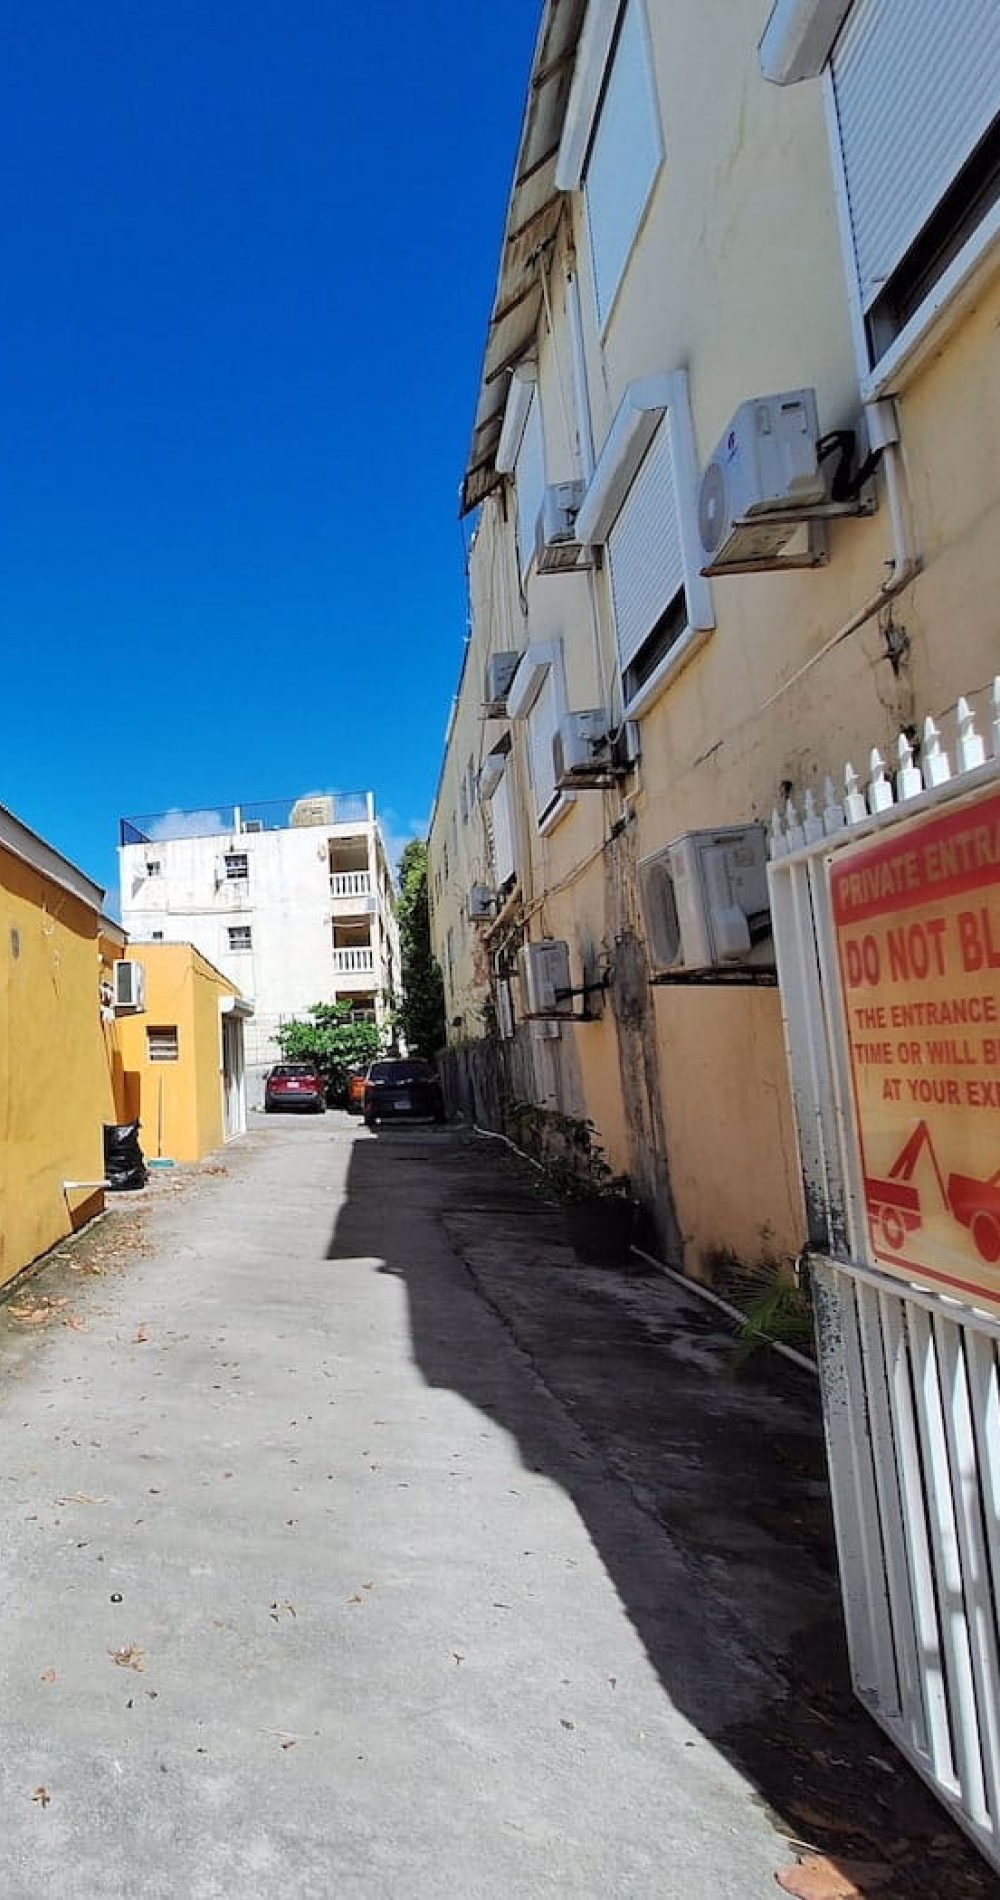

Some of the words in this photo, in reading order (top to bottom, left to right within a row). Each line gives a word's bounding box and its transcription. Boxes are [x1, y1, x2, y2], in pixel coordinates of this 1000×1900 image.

[838, 853, 921, 911] PRIVATE
[846, 935, 880, 988] DO
[887, 918, 946, 982] NOT
[854, 1007, 887, 1029] THE
[891, 996, 997, 1028] ENTRANCE
[854, 1042, 892, 1065] TIME
[898, 1042, 922, 1065] OR
[926, 1039, 977, 1065] WILL
[882, 1078, 902, 1101] AT
[906, 1079, 962, 1105] YOUR
